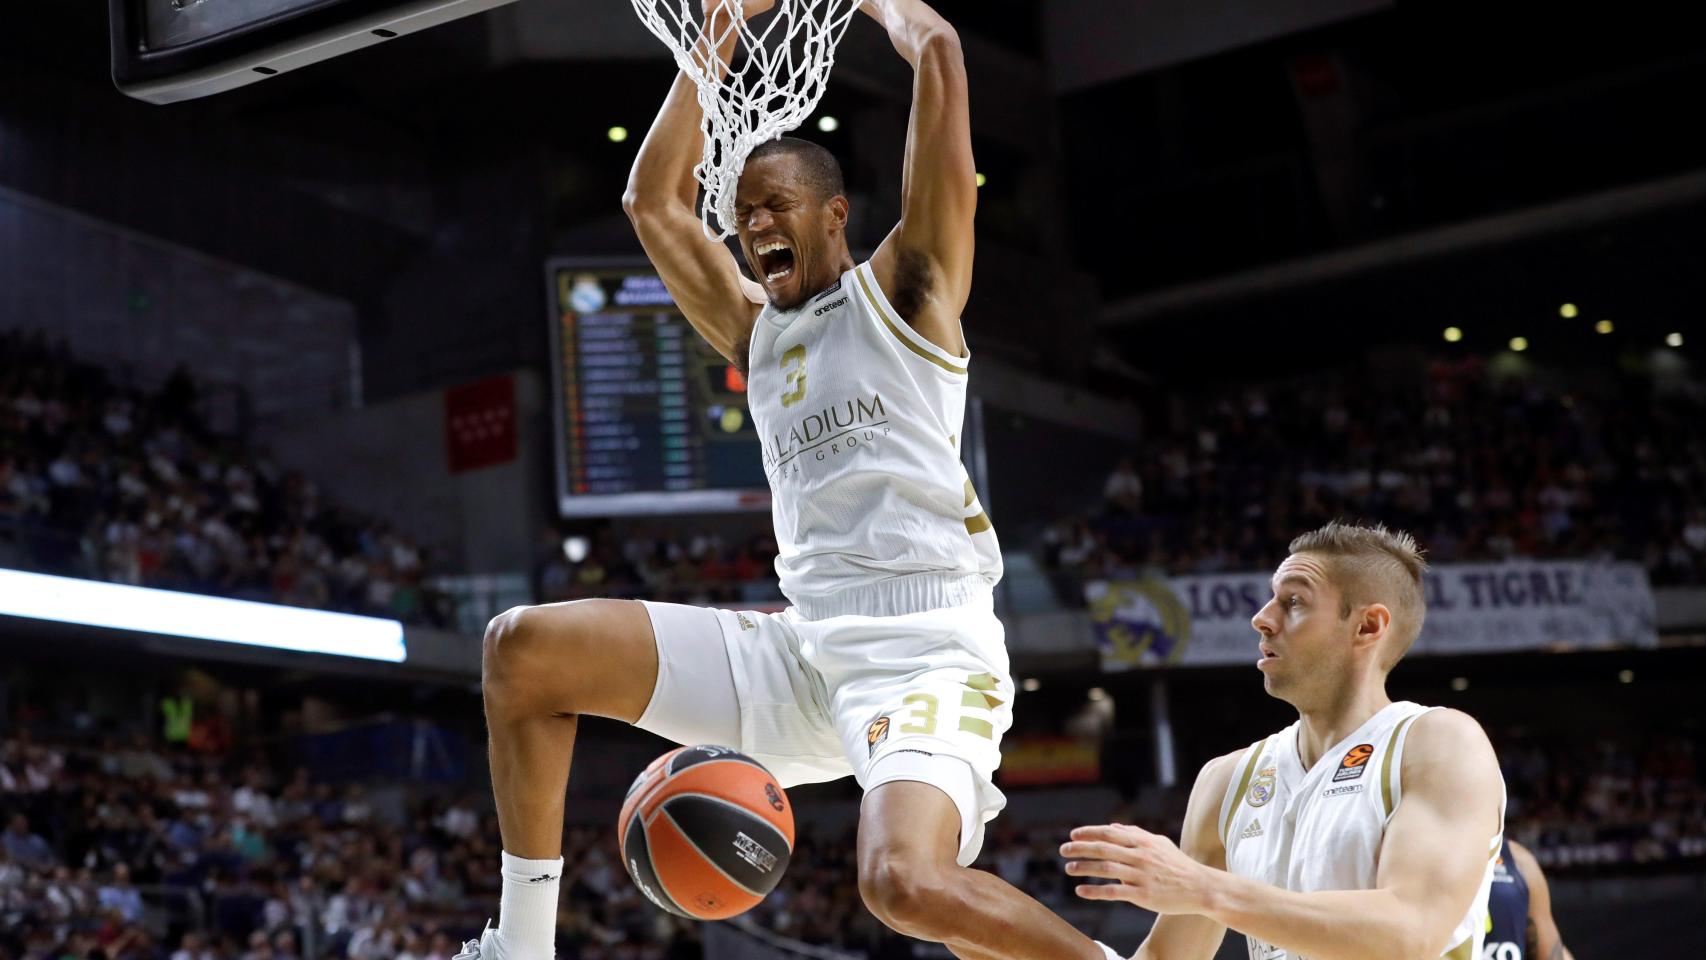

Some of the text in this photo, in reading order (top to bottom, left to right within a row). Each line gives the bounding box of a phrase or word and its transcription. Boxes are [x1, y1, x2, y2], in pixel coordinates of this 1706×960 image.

[814, 296, 848, 317] oneteam
[780, 344, 807, 409] 3
[815, 427, 890, 461] GROUP
[1187, 582, 1258, 619] LOS
[1461, 570, 1582, 609] TIGRE
[900, 693, 939, 734] 3
